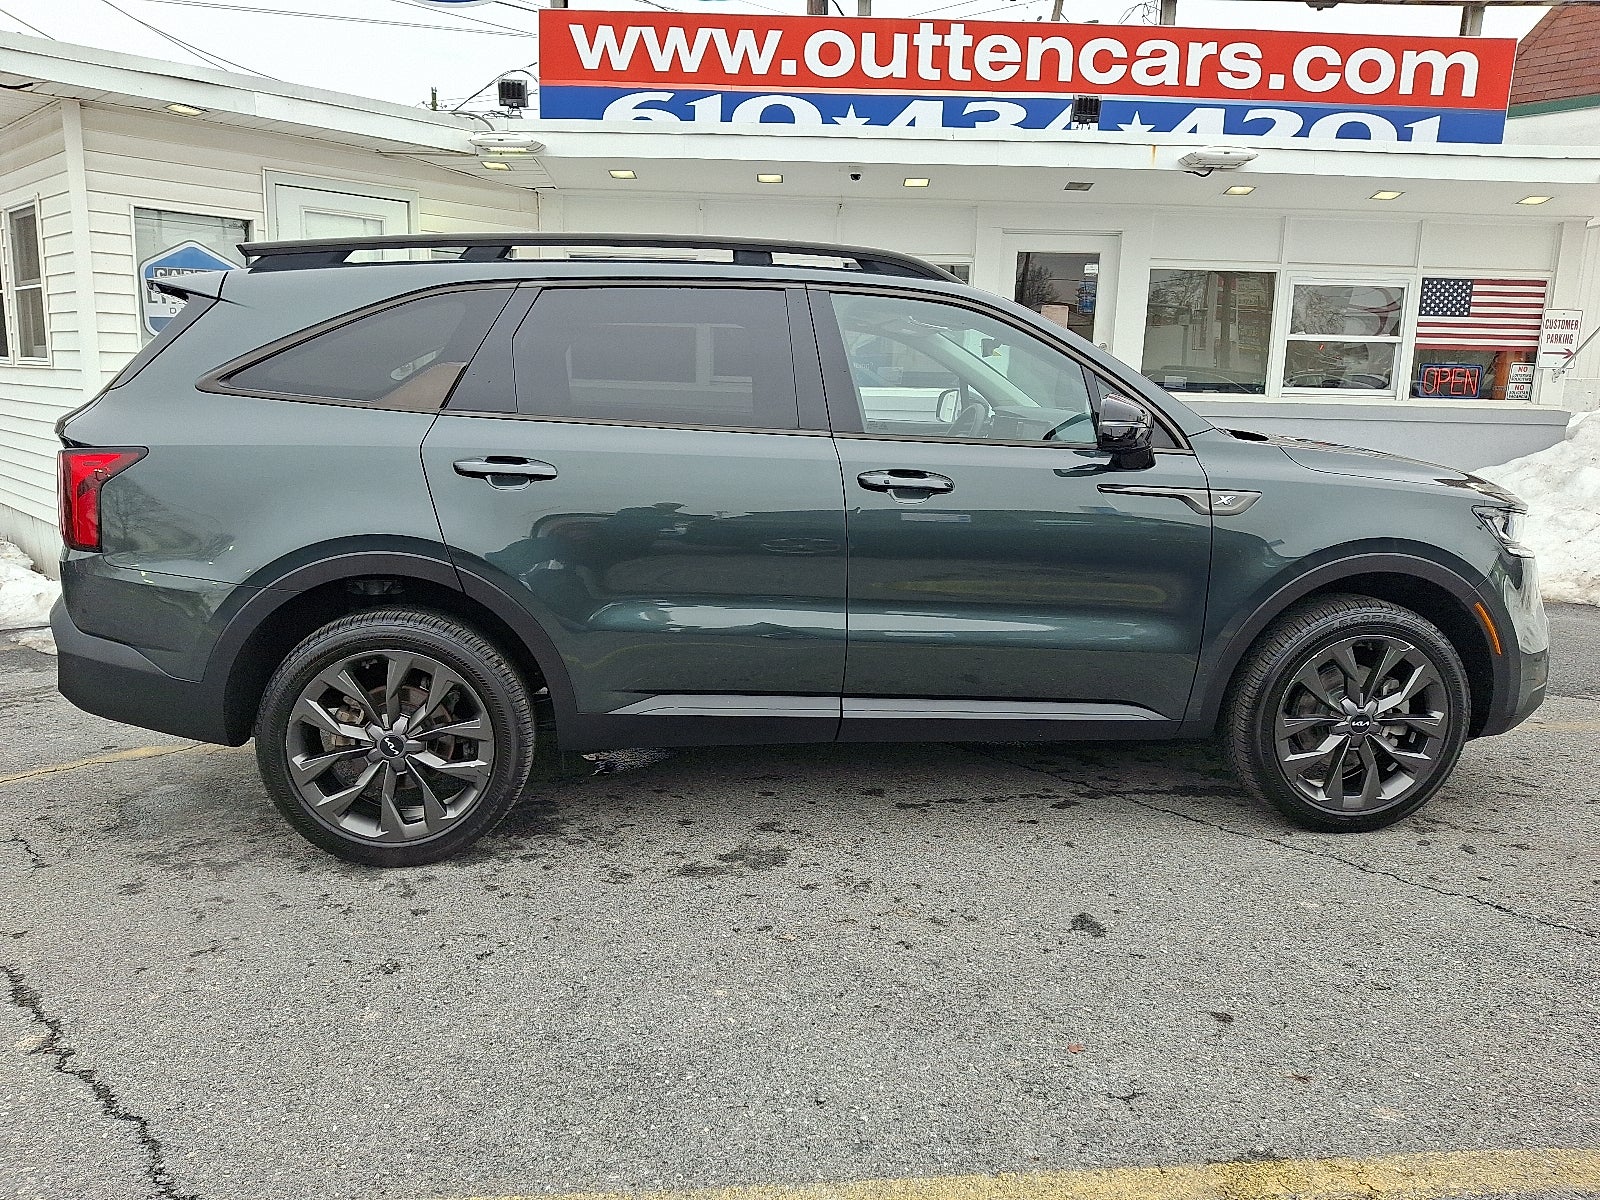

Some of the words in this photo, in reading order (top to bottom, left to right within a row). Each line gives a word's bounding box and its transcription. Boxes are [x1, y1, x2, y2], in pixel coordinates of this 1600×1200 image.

[568, 23, 1479, 98] www.outtencars.com
[887, 100, 1099, 130] 43
[1545, 319, 1579, 330] CUSTOMER
[1546, 333, 1574, 345] PARKING
[1424, 367, 1479, 395] OPEN
